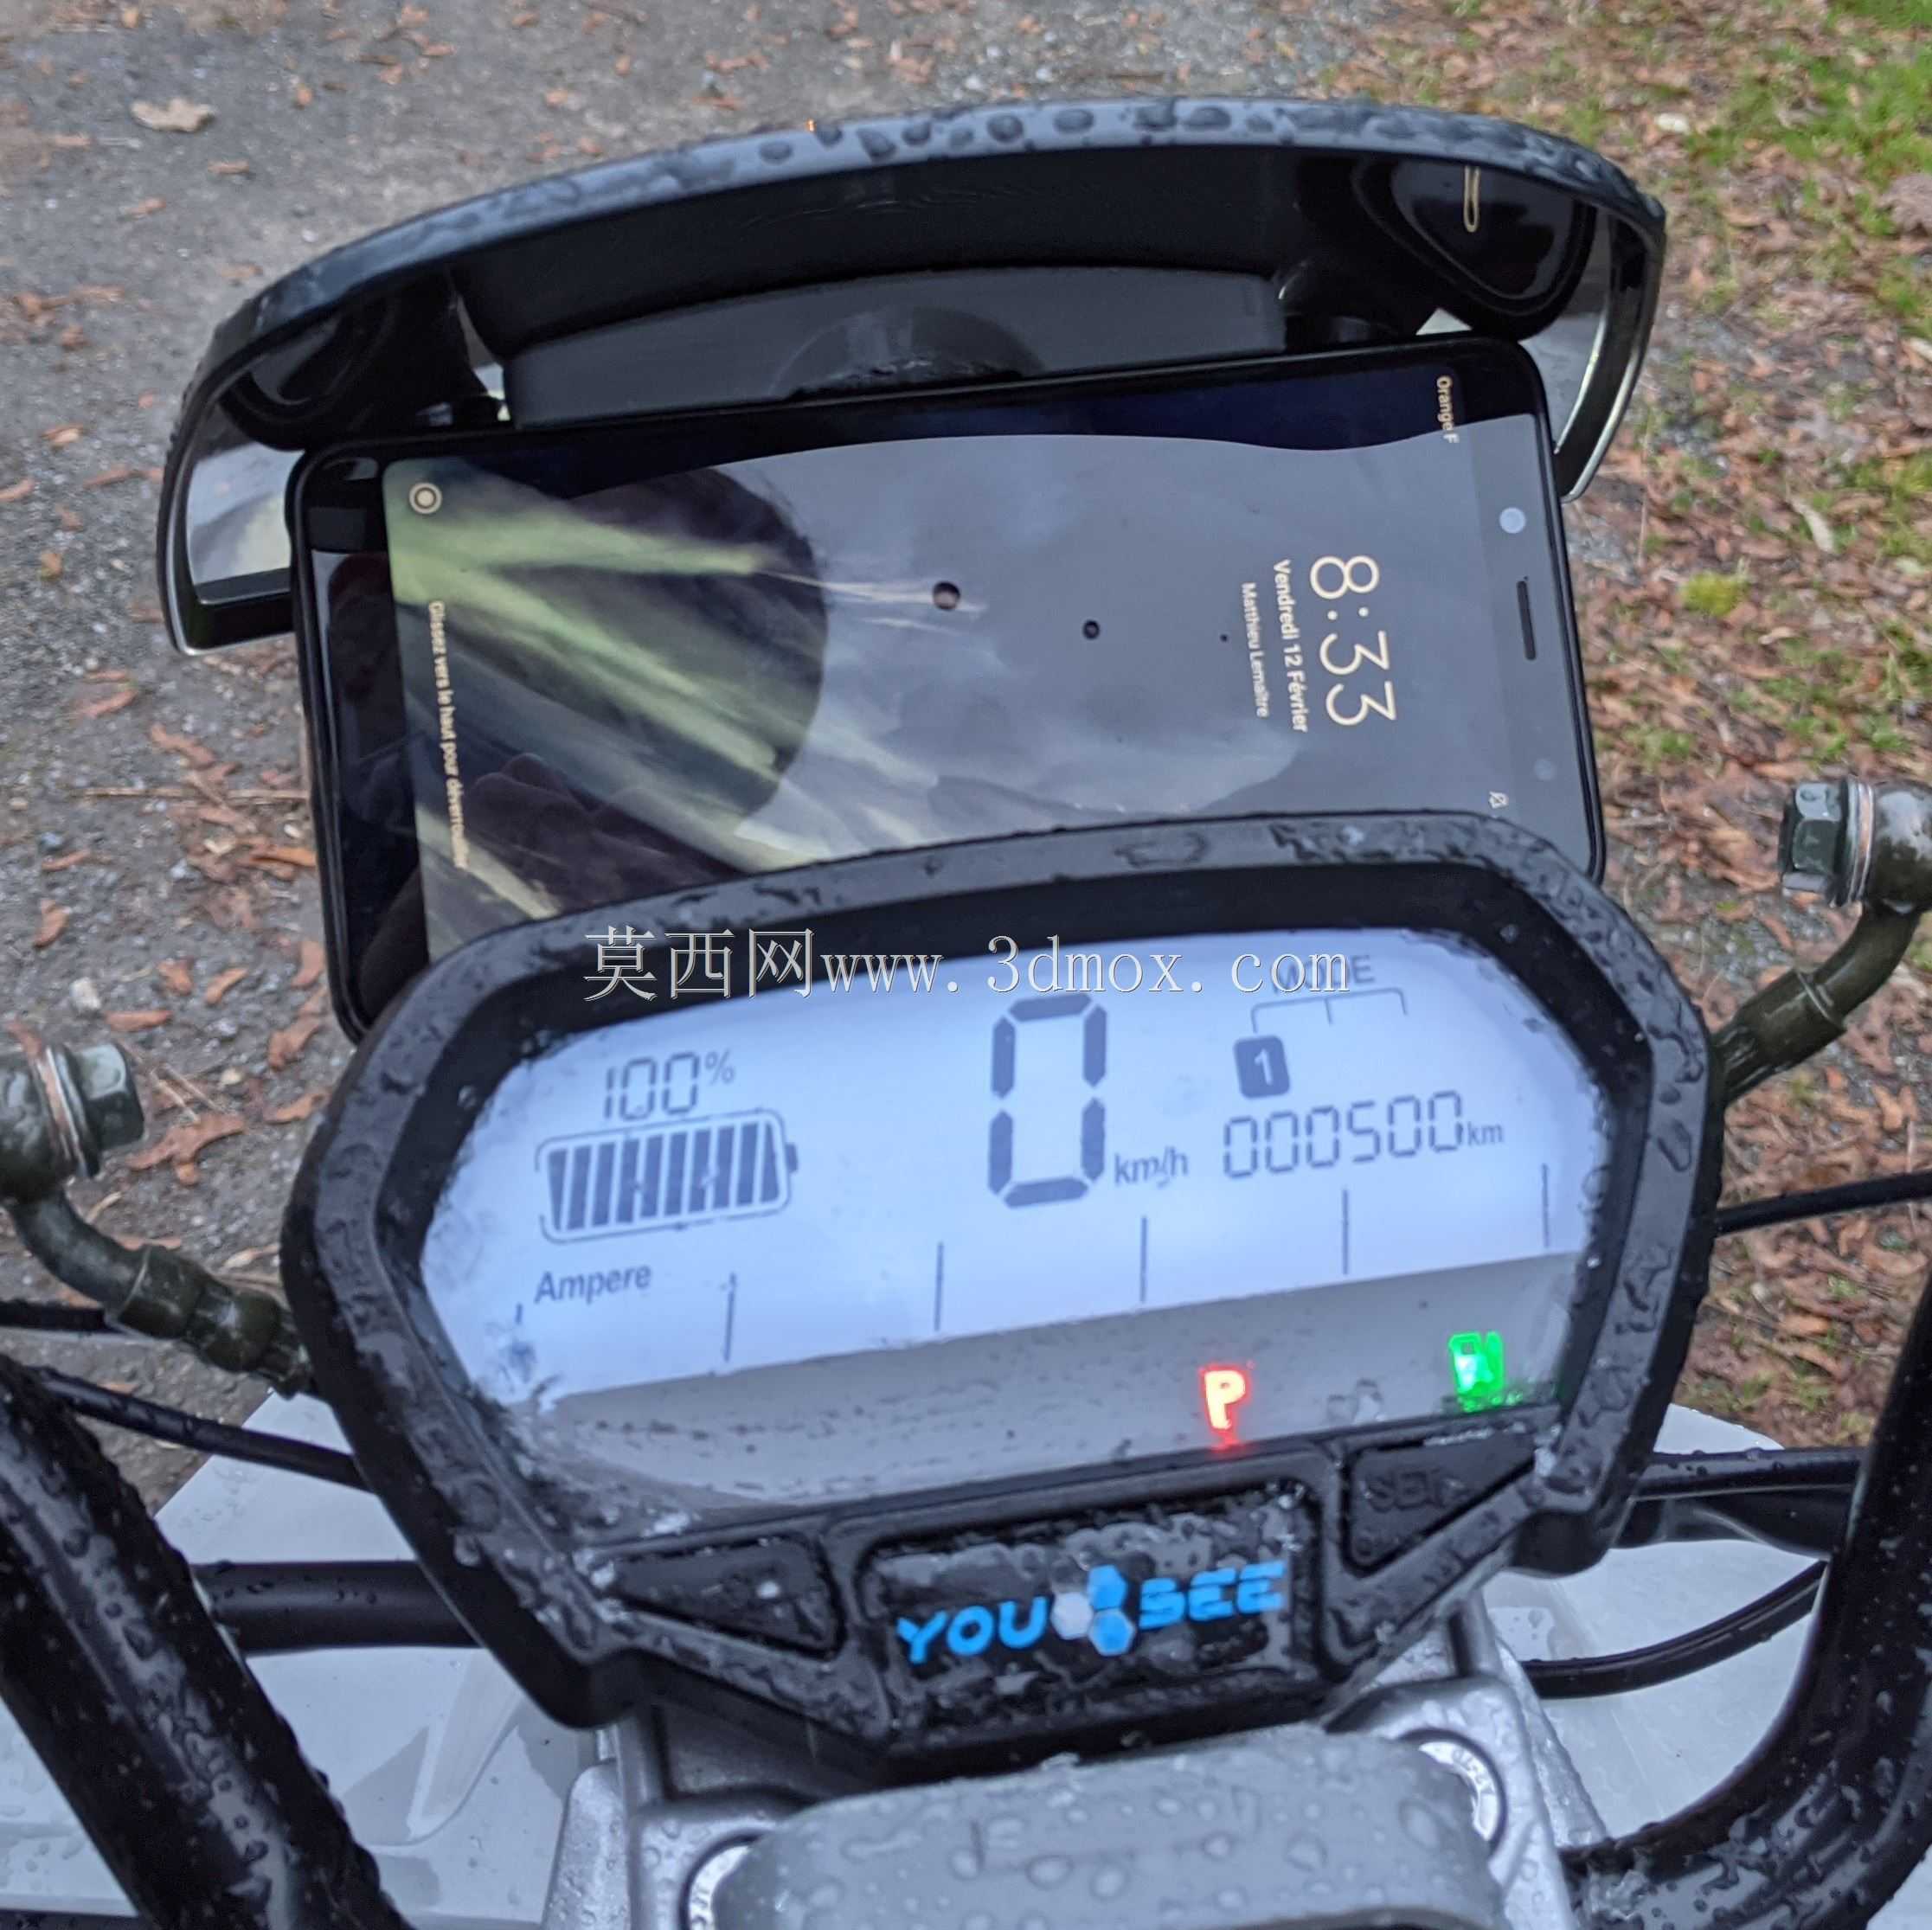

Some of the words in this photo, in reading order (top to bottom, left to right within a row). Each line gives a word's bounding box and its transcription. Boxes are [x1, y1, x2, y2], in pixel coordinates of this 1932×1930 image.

[1435, 375, 1454, 431] Orange
[429, 601, 446, 655] Glissez
[1241, 582, 1265, 651] Matthieu
[1273, 560, 1300, 640] Vendredi
[1283, 644, 1302, 667] 12
[1310, 555, 1396, 726] 8:33
[434, 657, 451, 689] vers
[438, 689, 454, 705] le
[1287, 671, 1309, 732] Février
[440, 706, 457, 740] haut
[440, 741, 459, 777] pour
[988, 992, 1107, 1209] 0
[1114, 1146, 1188, 1188] km/h
[1223, 1090, 1465, 1179] 000500
[1467, 1120, 1505, 1146] km
[534, 1265, 651, 1305] Ampere
[1203, 1369, 1246, 1430] P
[896, 1597, 1051, 1664] YOU
[1139, 1561, 1286, 1630] SEE
